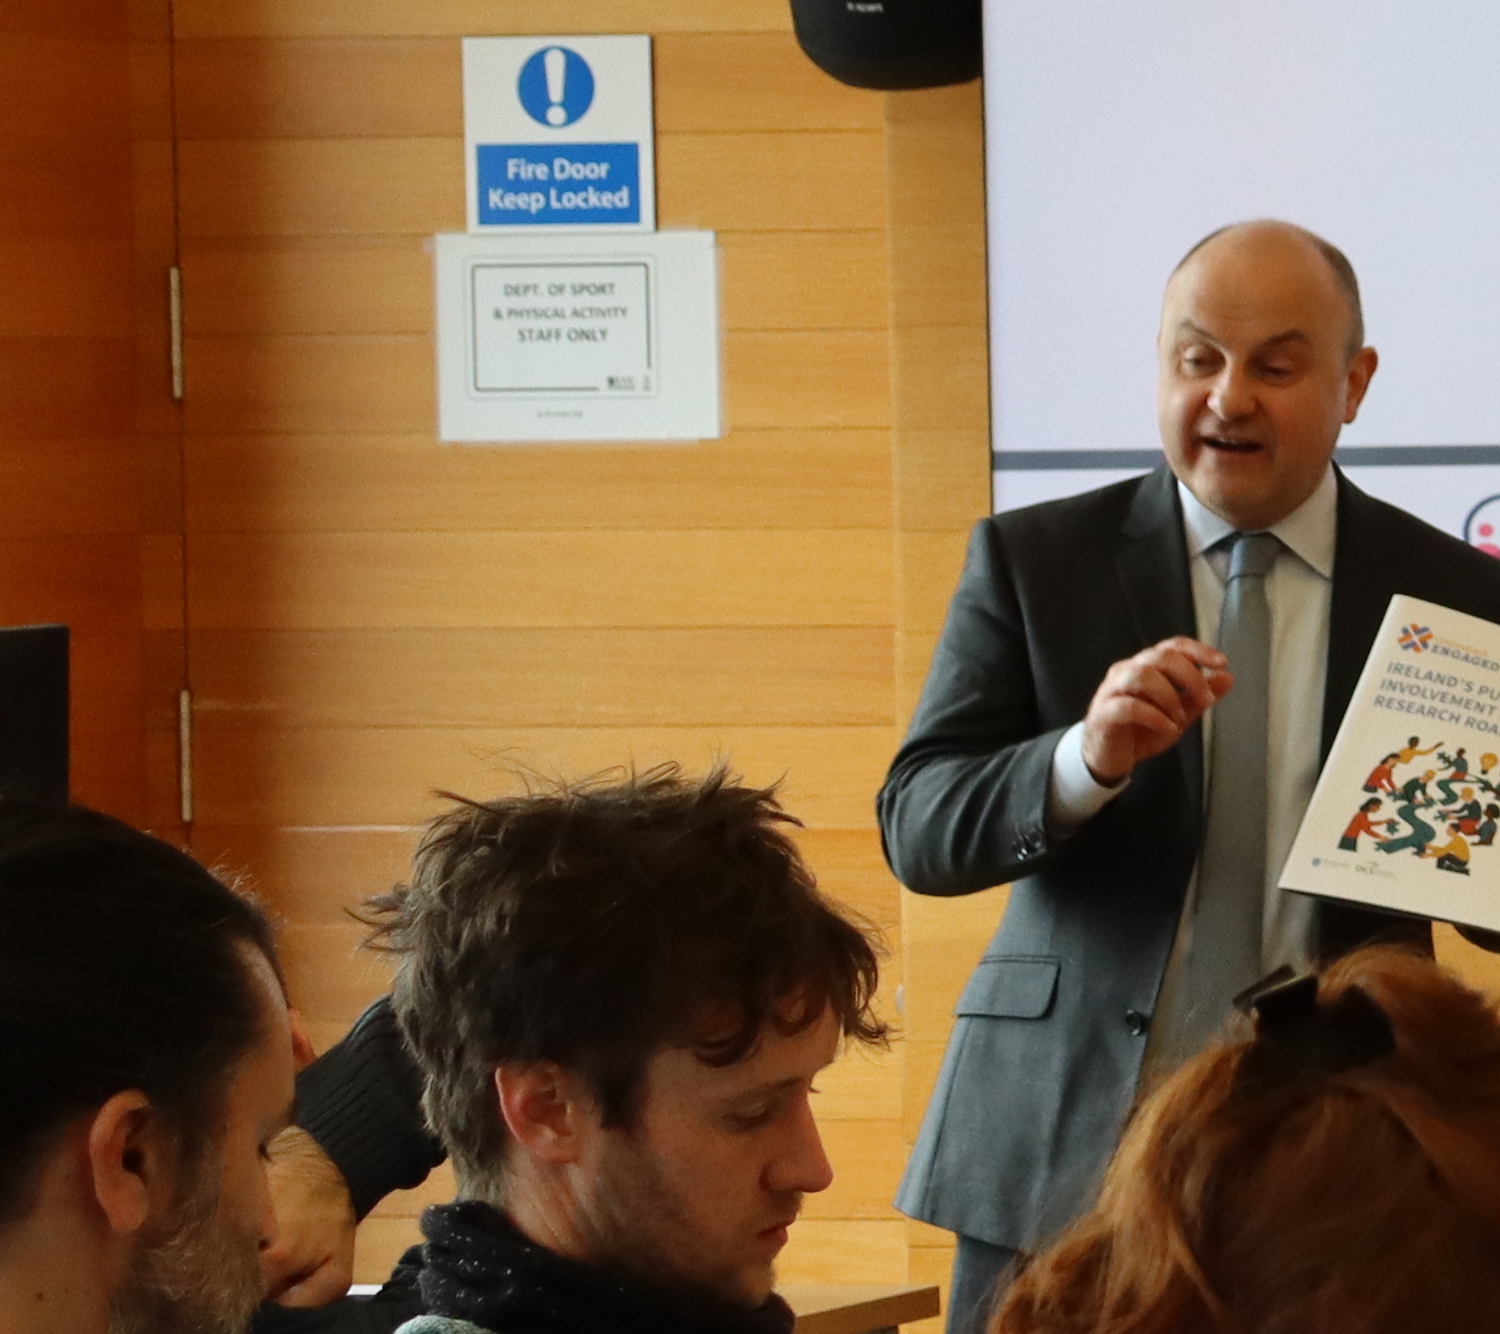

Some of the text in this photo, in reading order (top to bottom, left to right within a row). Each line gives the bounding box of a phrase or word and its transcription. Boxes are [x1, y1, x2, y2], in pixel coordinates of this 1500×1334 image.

[506, 157, 610, 181] Fire Door
[488, 186, 630, 215] Keep Locked
[547, 282, 566, 296] OF
[570, 281, 616, 297] SPORT
[507, 307, 567, 320] PHYSICAL
[570, 306, 628, 319] ACTIVITY
[517, 327, 609, 343] STAFF ONLY
[1429, 643, 1500, 672] ENGAGED
[1380, 677, 1497, 714] INVOLVEMENT
[1373, 694, 1461, 725] RESEARCH
